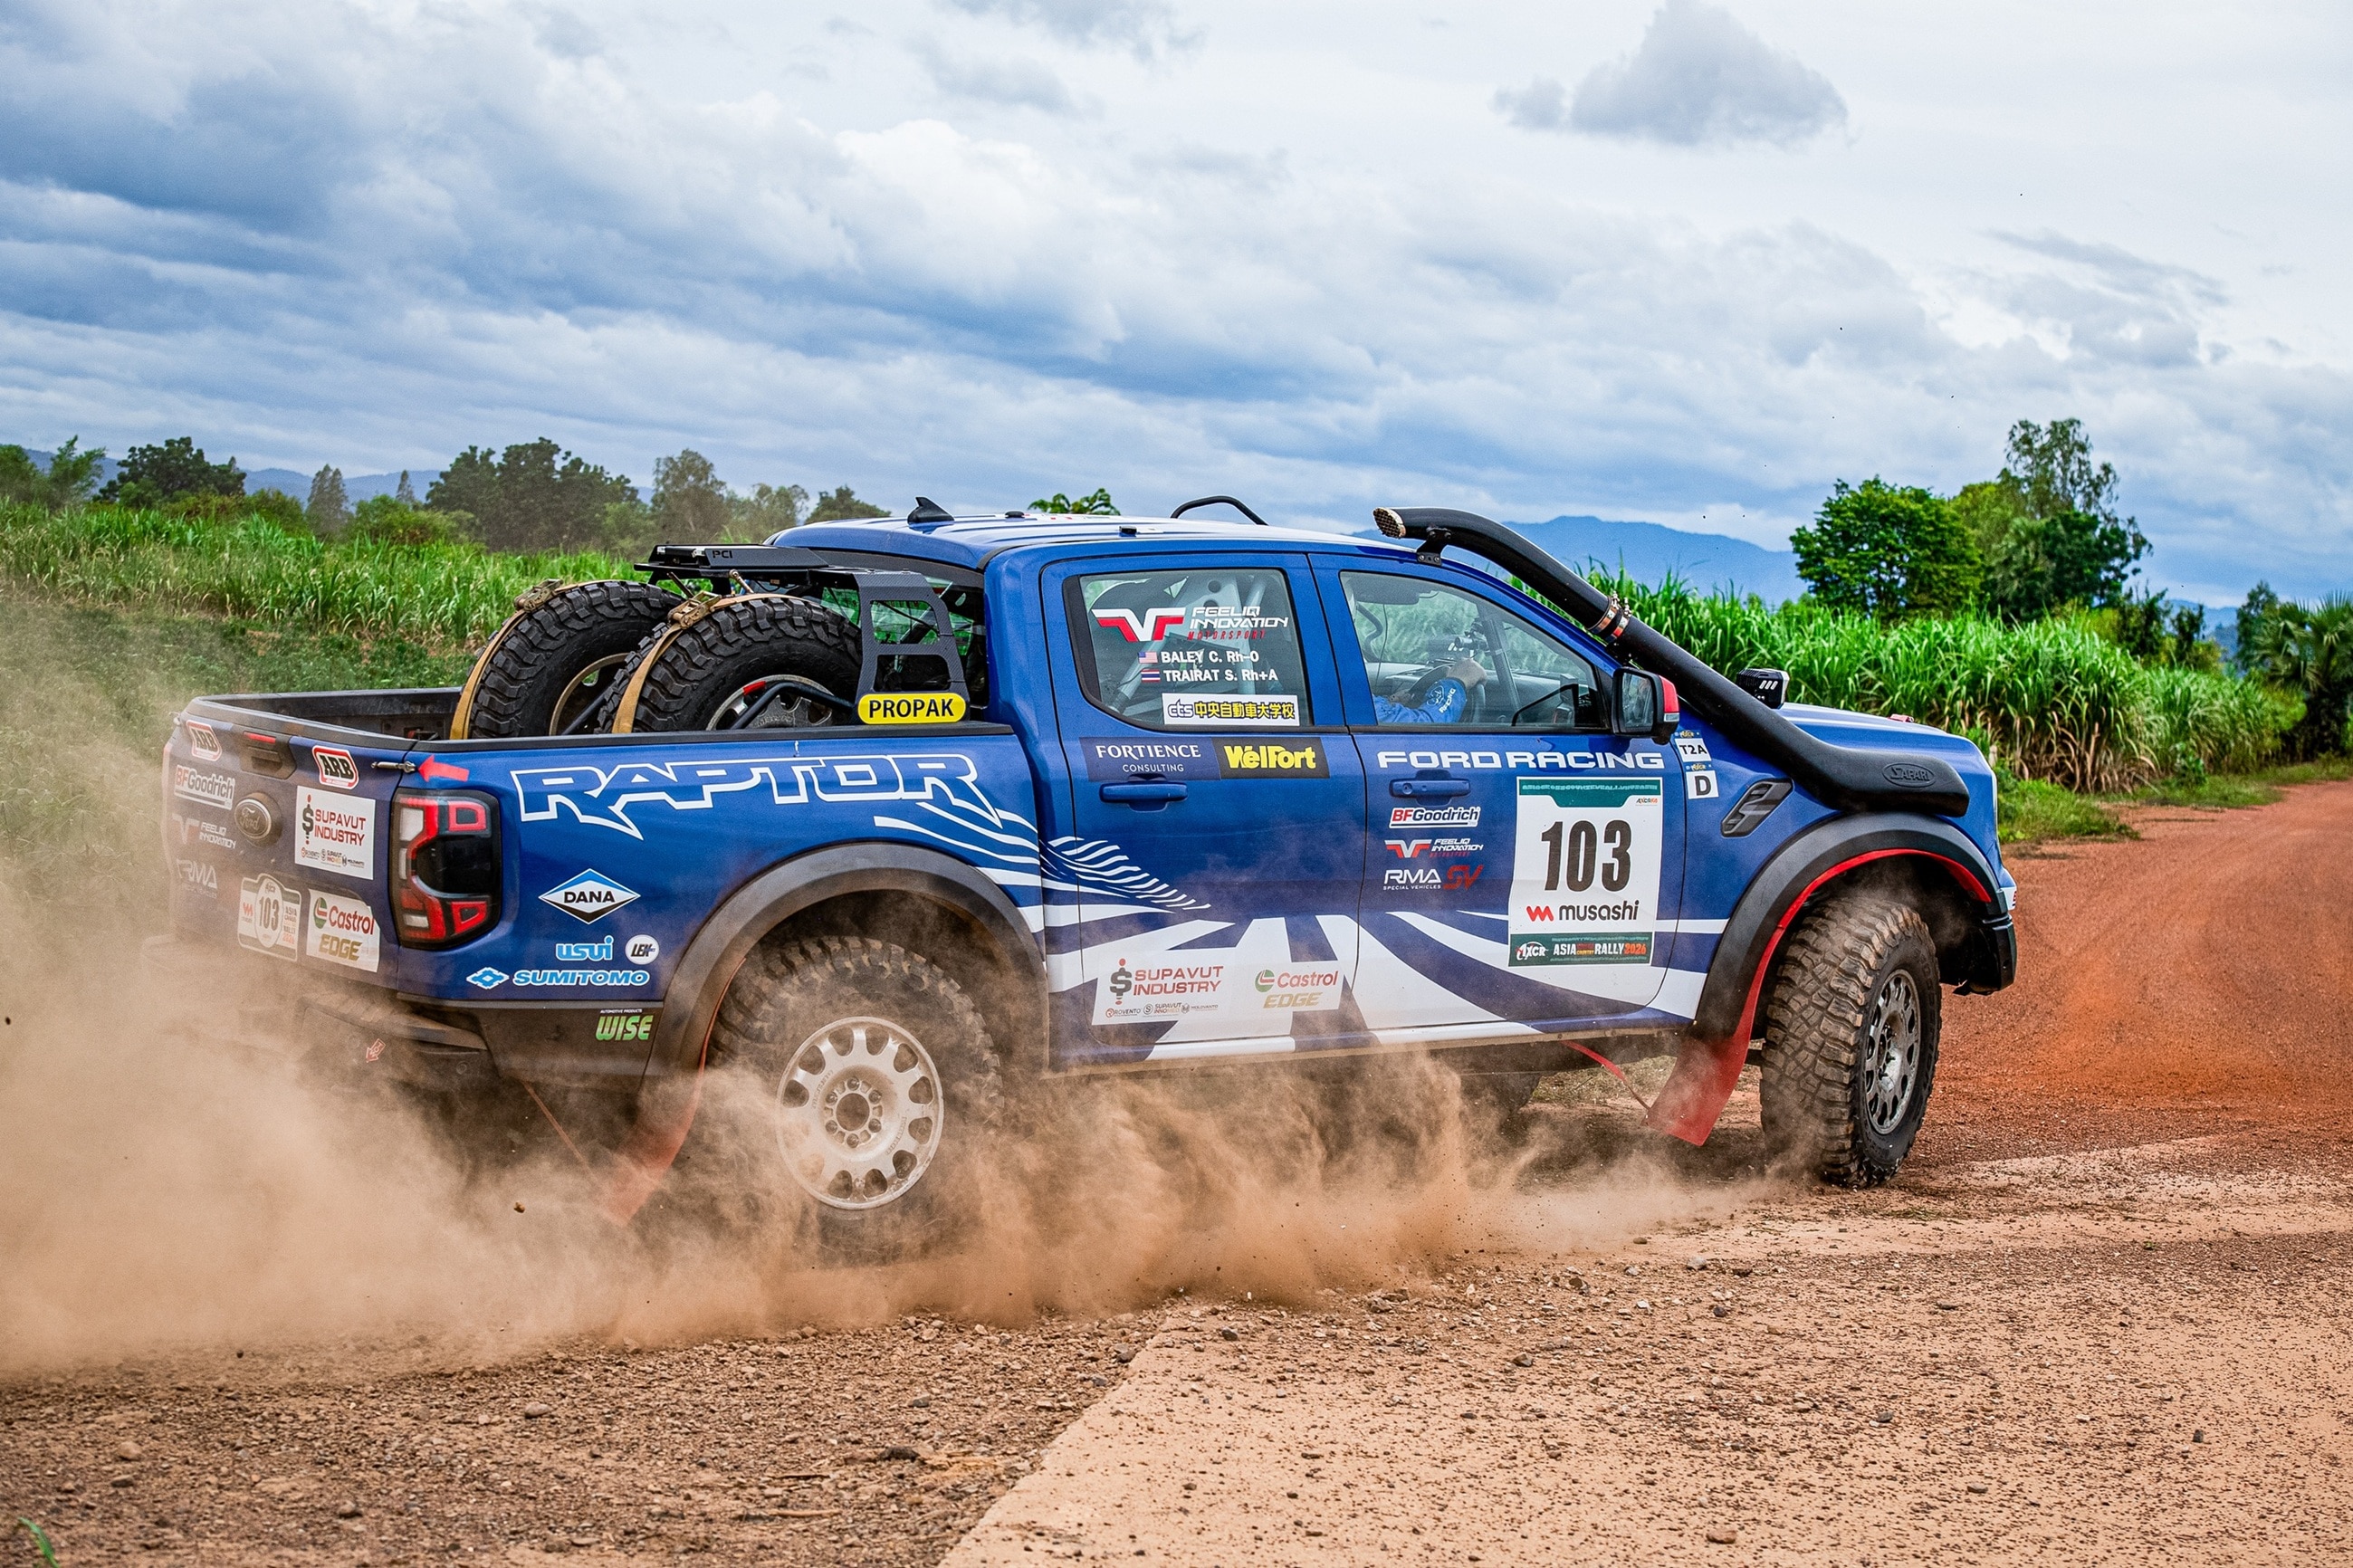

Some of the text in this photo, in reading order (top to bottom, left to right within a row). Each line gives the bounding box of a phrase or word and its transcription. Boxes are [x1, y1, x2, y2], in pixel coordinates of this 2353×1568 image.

[713, 550, 732, 559] PCI
[1192, 607, 1260, 617] FEELIQ
[1190, 617, 1288, 629] INNOVATION
[1187, 630, 1265, 640] MOTORSPORT
[1162, 651, 1204, 663] BALEY
[1209, 651, 1222, 663] C.
[1163, 669, 1278, 682] TRAIRAT S. Rh+A
[869, 699, 953, 719] PROPAK
[1194, 701, 1295, 719] 中央自動車大学校
[190, 727, 218, 752] ARB
[1095, 745, 1201, 760] FORTIENCE
[1679, 744, 1707, 755] T2A
[320, 755, 353, 779] ARB
[1123, 764, 1184, 772] CONSULTING
[1377, 751, 1664, 770] FORD RACING
[1889, 767, 1930, 782] SAFARI
[176, 767, 234, 799] BFGoodrich
[1695, 776, 1711, 796] D
[510, 753, 1003, 840] RAPTOR
[315, 809, 366, 830] SUPAVUT
[1392, 808, 1478, 821] BFGoodrich
[314, 825, 365, 846] INDUSTRY
[1542, 820, 1632, 893] 103
[1384, 868, 1441, 884] RMA
[564, 891, 616, 904] DANA
[259, 896, 279, 932] 103
[1559, 900, 1640, 922] musashi
[329, 905, 375, 935] Castrol
[319, 933, 362, 961] EDGE
[1553, 943, 1576, 956] ASIA
[1594, 942, 1625, 955] RALLY
[512, 970, 650, 986] SUMITOMO
[1134, 966, 1224, 981] SUPAVUT
[1277, 970, 1339, 989] Castrol
[1133, 980, 1222, 996] INDUSTRY
[1263, 992, 1323, 1009] EDGE
[596, 1015, 654, 1041] WISE
